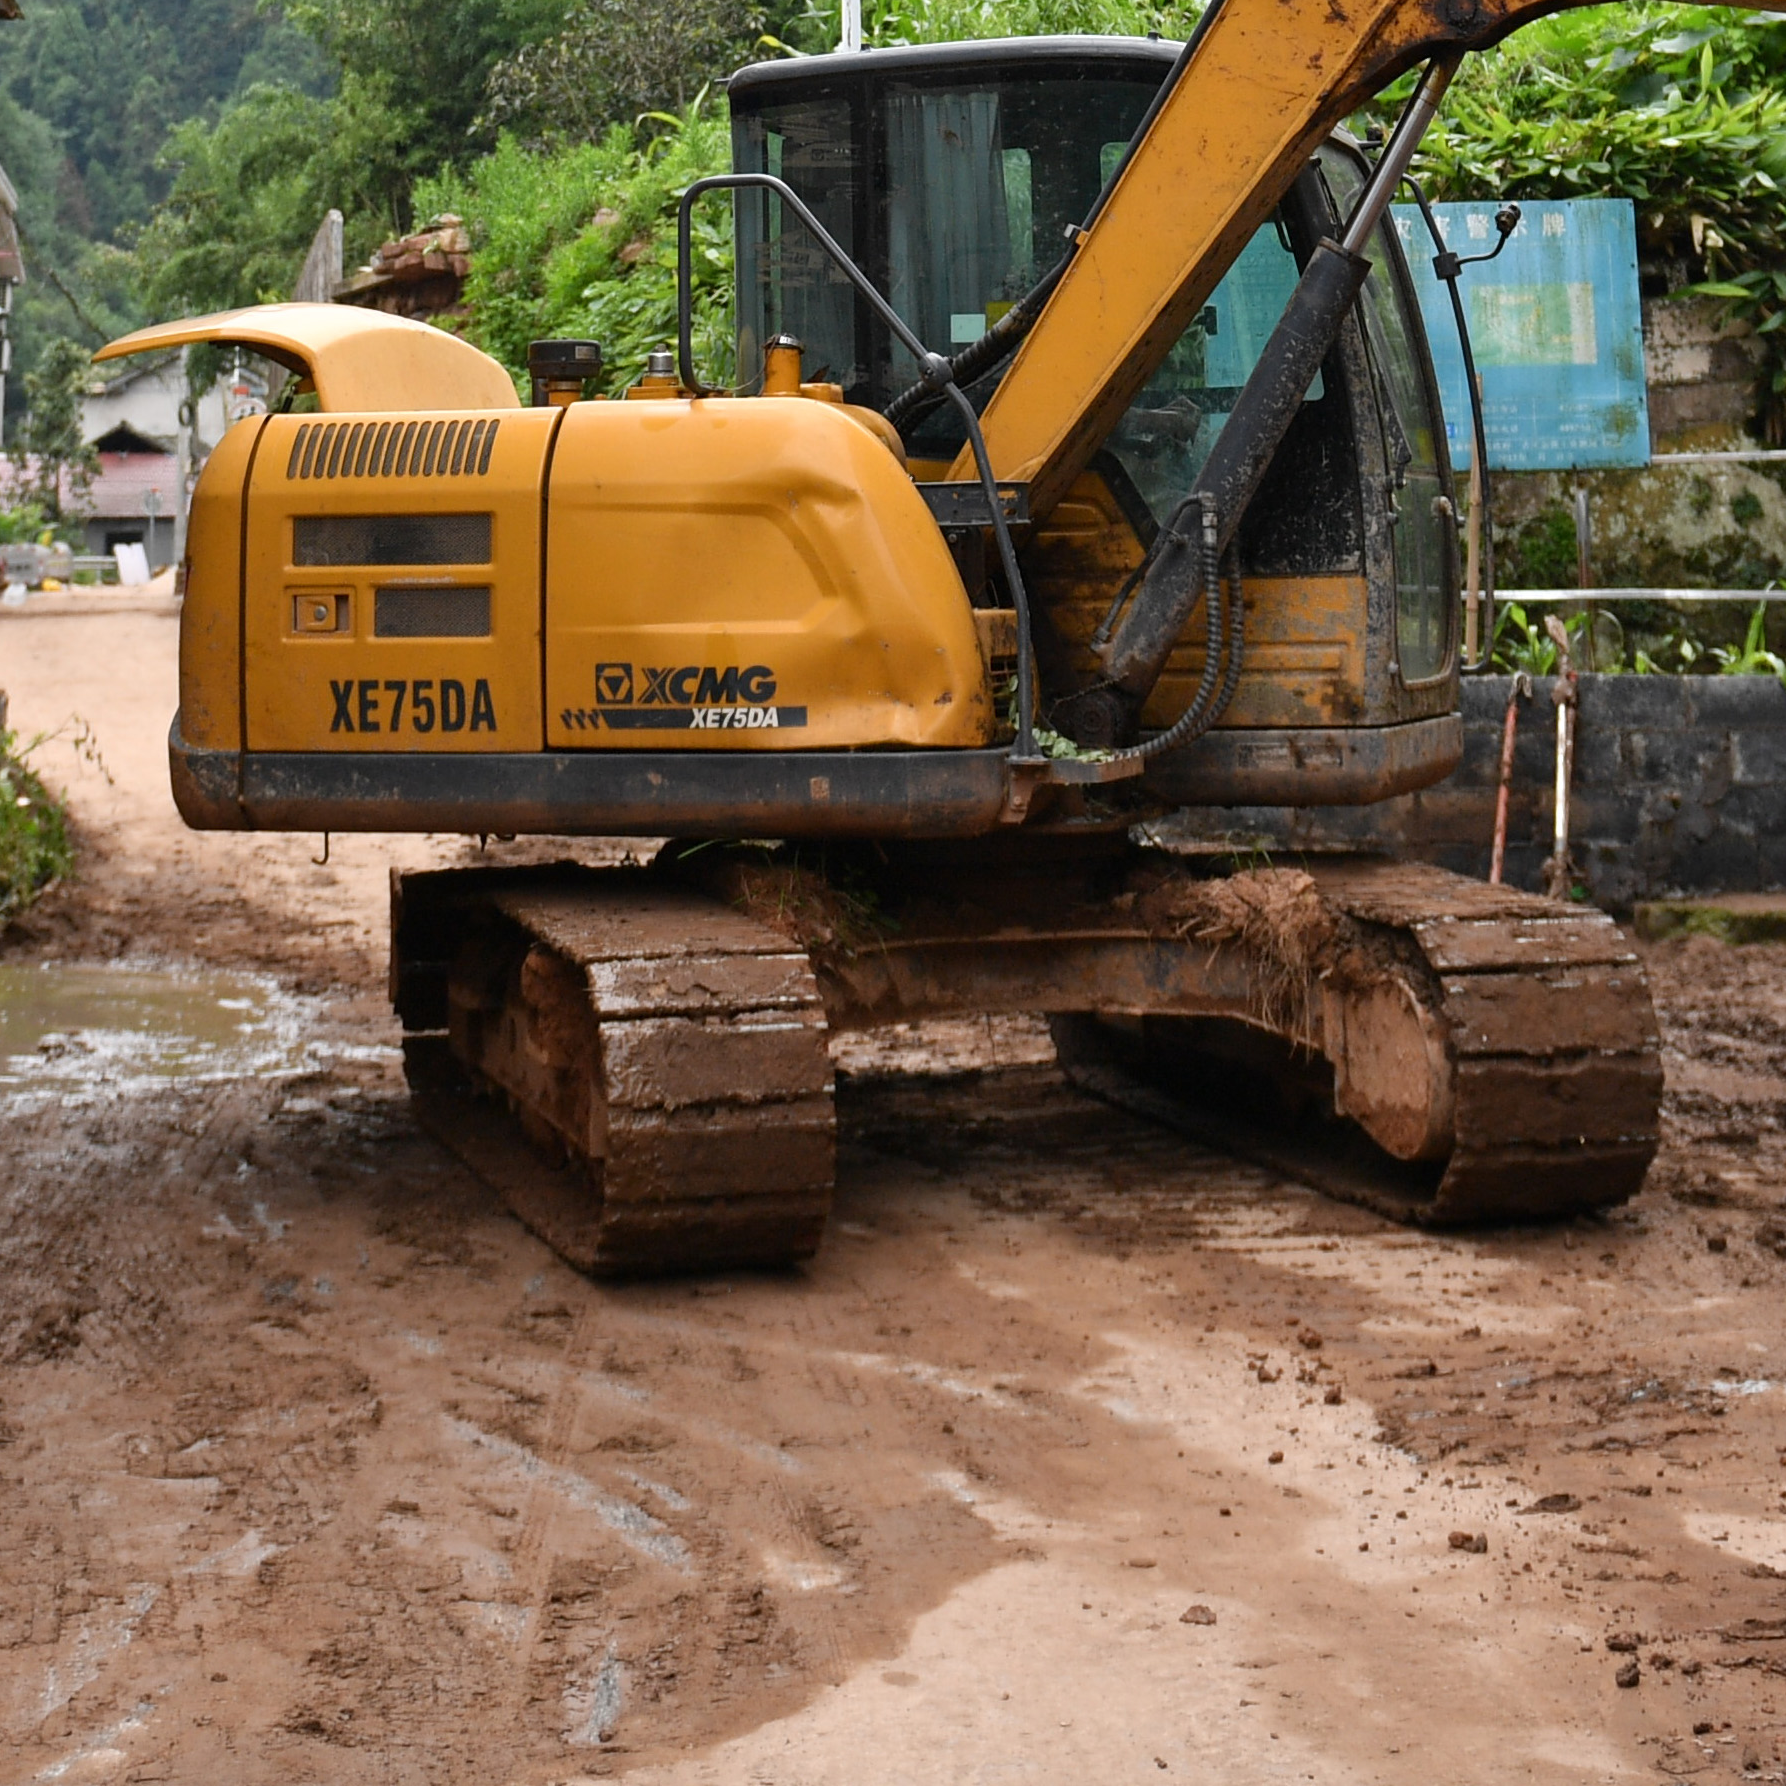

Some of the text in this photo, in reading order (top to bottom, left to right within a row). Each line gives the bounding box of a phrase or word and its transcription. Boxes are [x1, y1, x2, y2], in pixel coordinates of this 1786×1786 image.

[638, 664, 777, 705] XCMG
[329, 678, 498, 733] XE75DA
[689, 705, 779, 729] XE75DA
